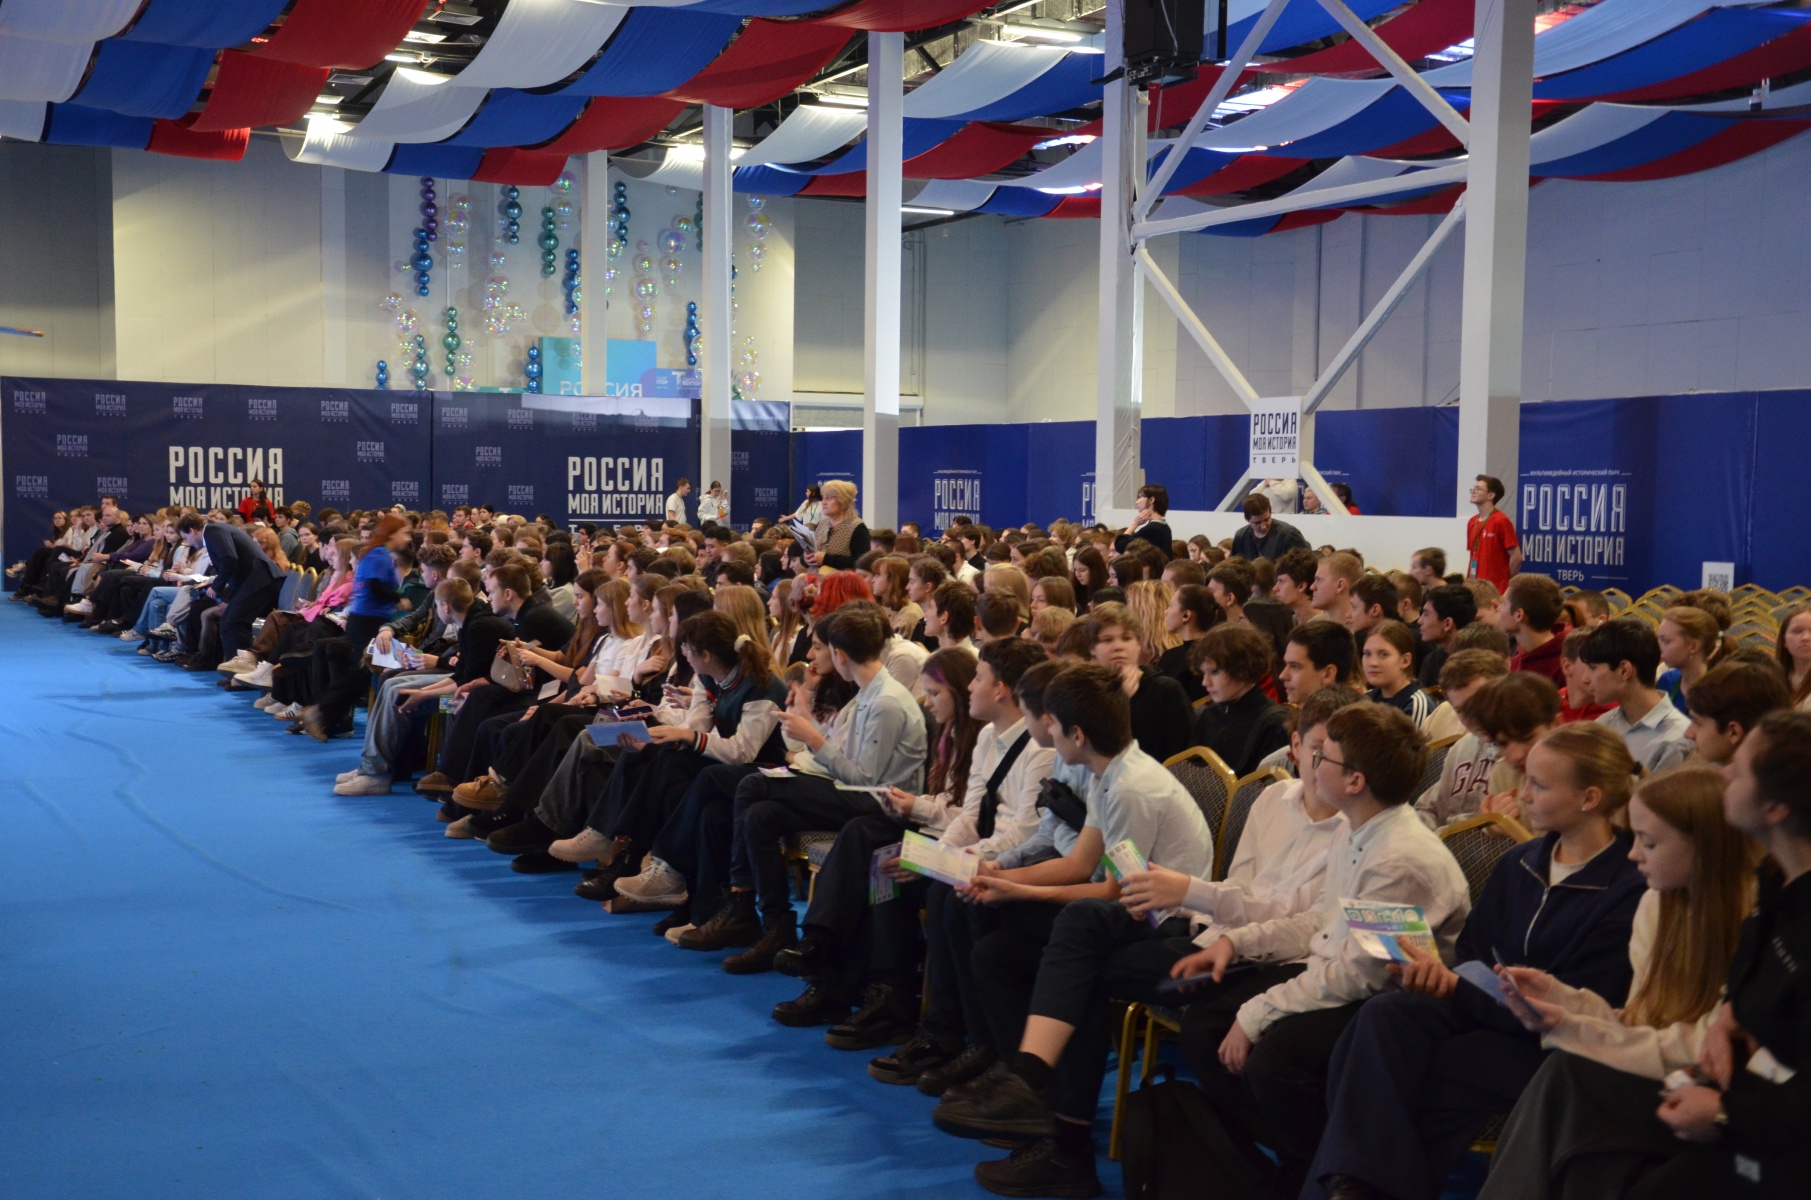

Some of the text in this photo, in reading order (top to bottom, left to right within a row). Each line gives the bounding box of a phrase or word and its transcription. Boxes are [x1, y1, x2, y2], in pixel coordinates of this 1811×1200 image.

[560, 381, 642, 397] РОСИЯ
[14, 391, 46, 401] РОССИЯ
[96, 394, 126, 405] РОССИЯ
[173, 397, 202, 407] РОССИЯ
[248, 399, 277, 409] РОССИЯ
[321, 401, 348, 411] РОССИЯ
[391, 403, 418, 412] РОССИЯ
[1253, 412, 1297, 435] РОССИЯ
[57, 435, 88, 445] РОССИЯ
[1252, 436, 1297, 450] МОЯ ИСТОРИЯ
[357, 441, 384, 451] РОССИЯ
[476, 446, 501, 456] РОССИЯ
[169, 446, 283, 484] РОССИЯ
[568, 457, 663, 491] РОССИЯ
[16, 476, 48, 486] РОССИЯ
[97, 477, 127, 487] РОССИЯ
[322, 480, 349, 490] РОССИЯ
[392, 481, 419, 490] РОССИЯ
[442, 485, 468, 494] РОССИЯ
[508, 485, 533, 494] РОССИЯ
[170, 486, 206, 509] МОЯ
[934, 479, 980, 511] РОССИЯ
[568, 494, 663, 514] МОЯ ИСТОРИЯ
[1523, 484, 1626, 532] РОССИЯ
[934, 512, 950, 531] МОЯ
[1522, 534, 1625, 566] МОЯ ИСТОРИЯ
[1557, 569, 1585, 581] ТВЕРЬ
